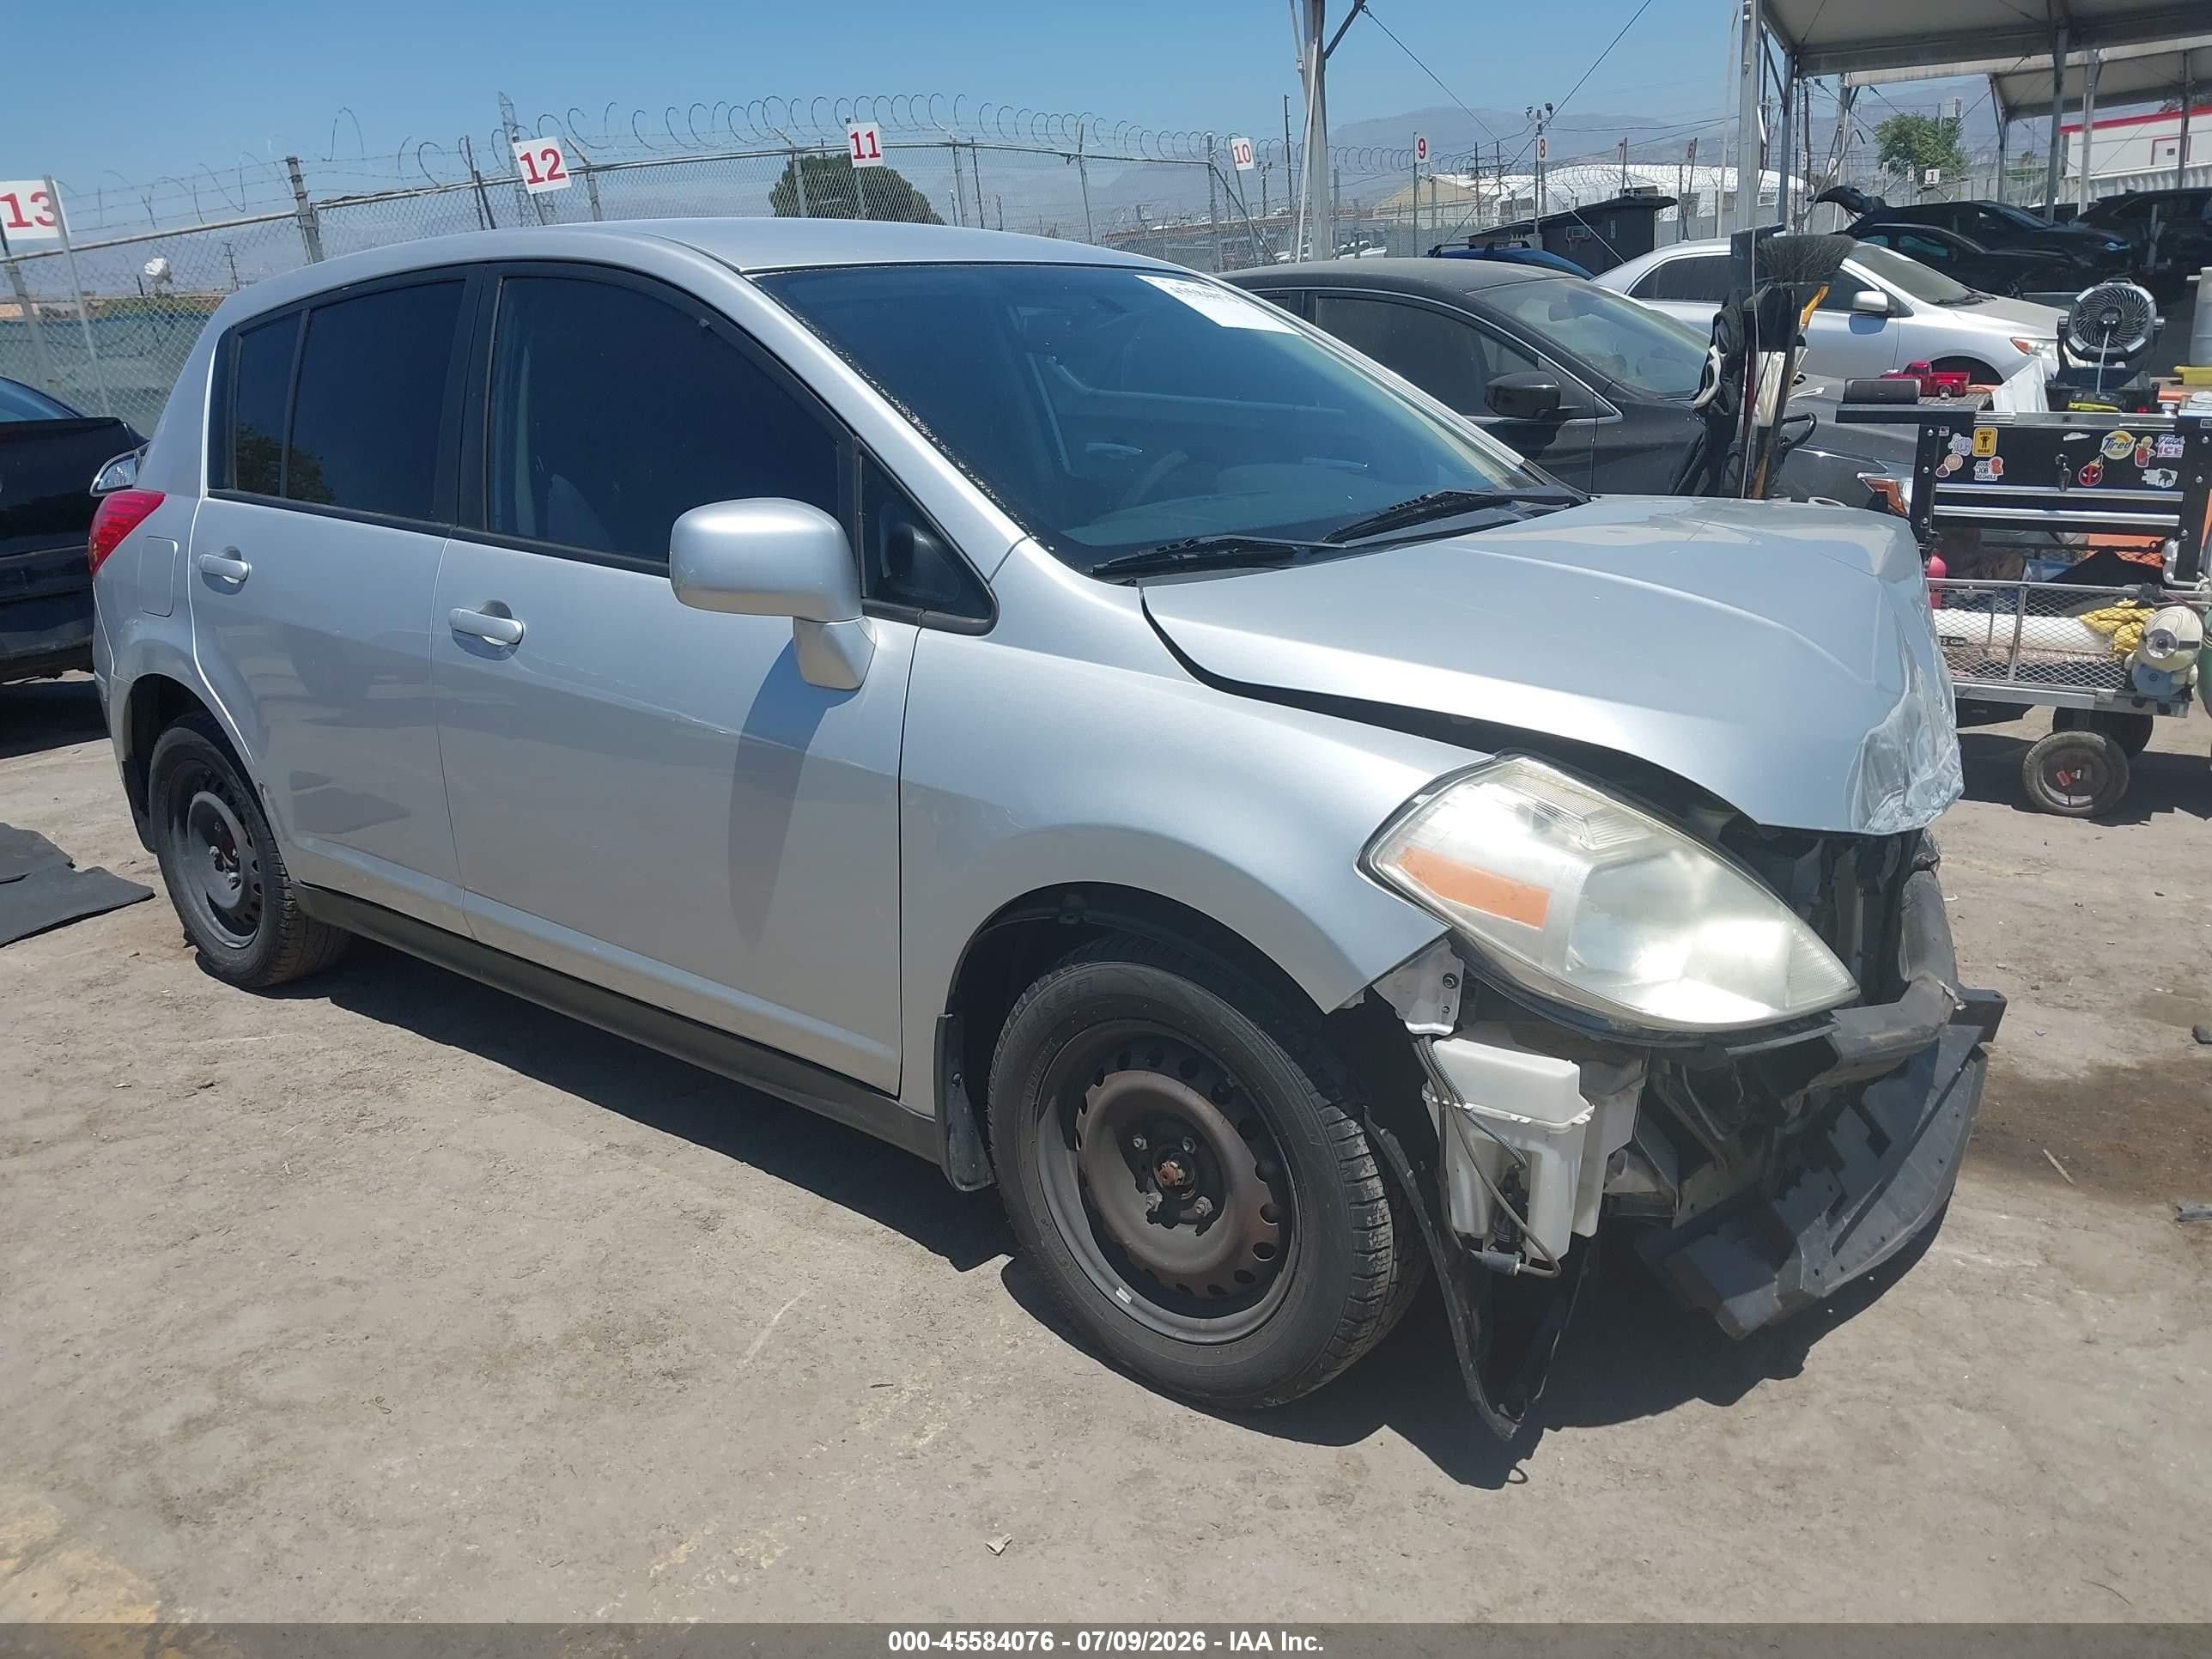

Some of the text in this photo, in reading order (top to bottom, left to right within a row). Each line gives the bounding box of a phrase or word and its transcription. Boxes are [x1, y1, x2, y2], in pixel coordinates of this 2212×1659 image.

[850, 131, 881, 160] 11
[1233, 143, 1251, 164] 10
[1418, 137, 1426, 160] 9
[1540, 138, 1546, 158] 8
[1687, 142, 1693, 158] 6
[520, 149, 567, 185] 12
[0, 191, 58, 228] 13
[2102, 436, 2135, 452] Tired
[2158, 446, 2182, 455] ICE
